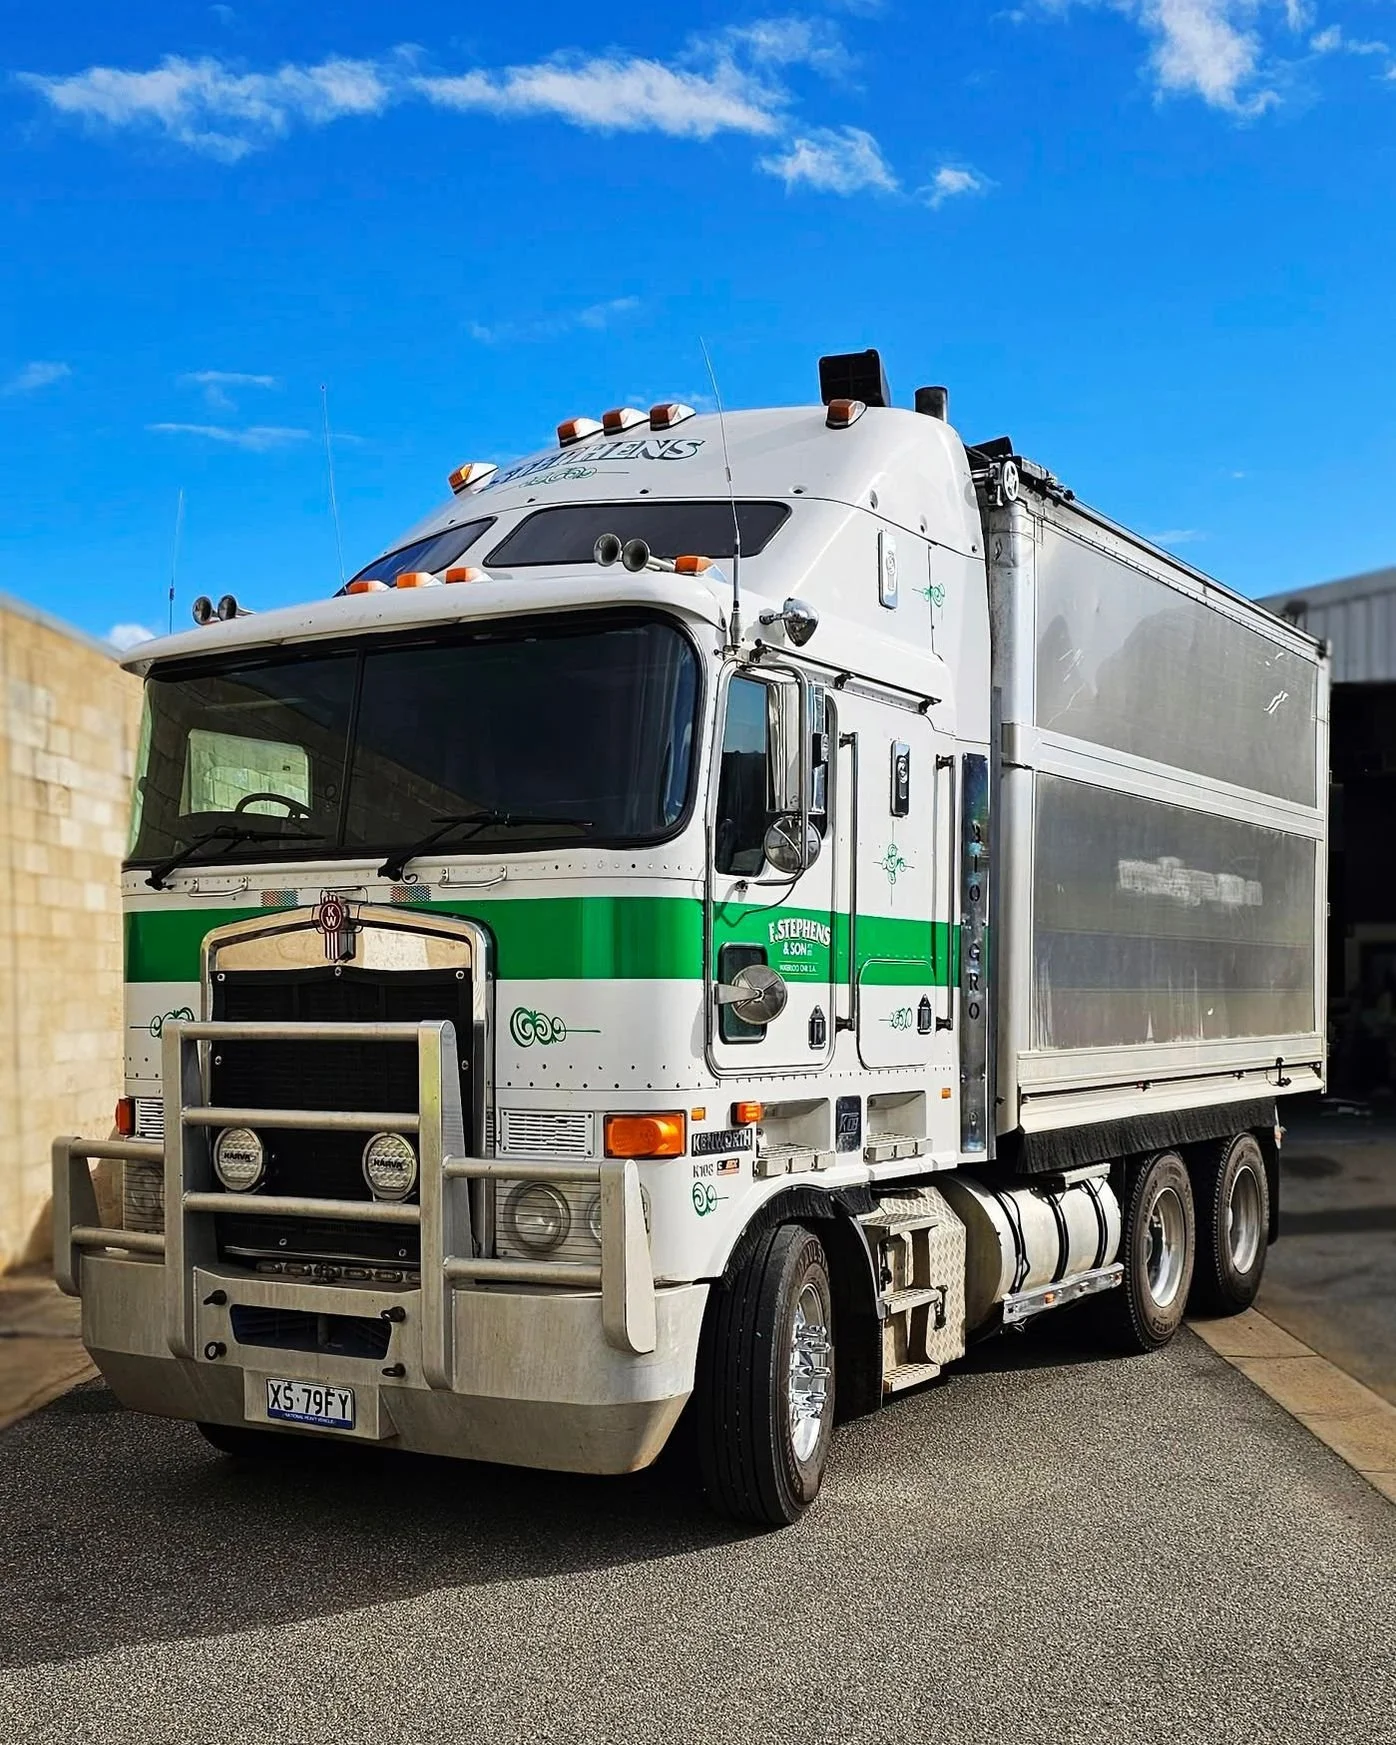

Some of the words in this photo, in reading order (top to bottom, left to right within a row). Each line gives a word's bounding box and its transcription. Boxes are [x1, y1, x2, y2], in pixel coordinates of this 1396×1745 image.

[782, 942, 790, 955] &
[790, 942, 807, 956] SON
[692, 1129, 752, 1152] KENWORTH
